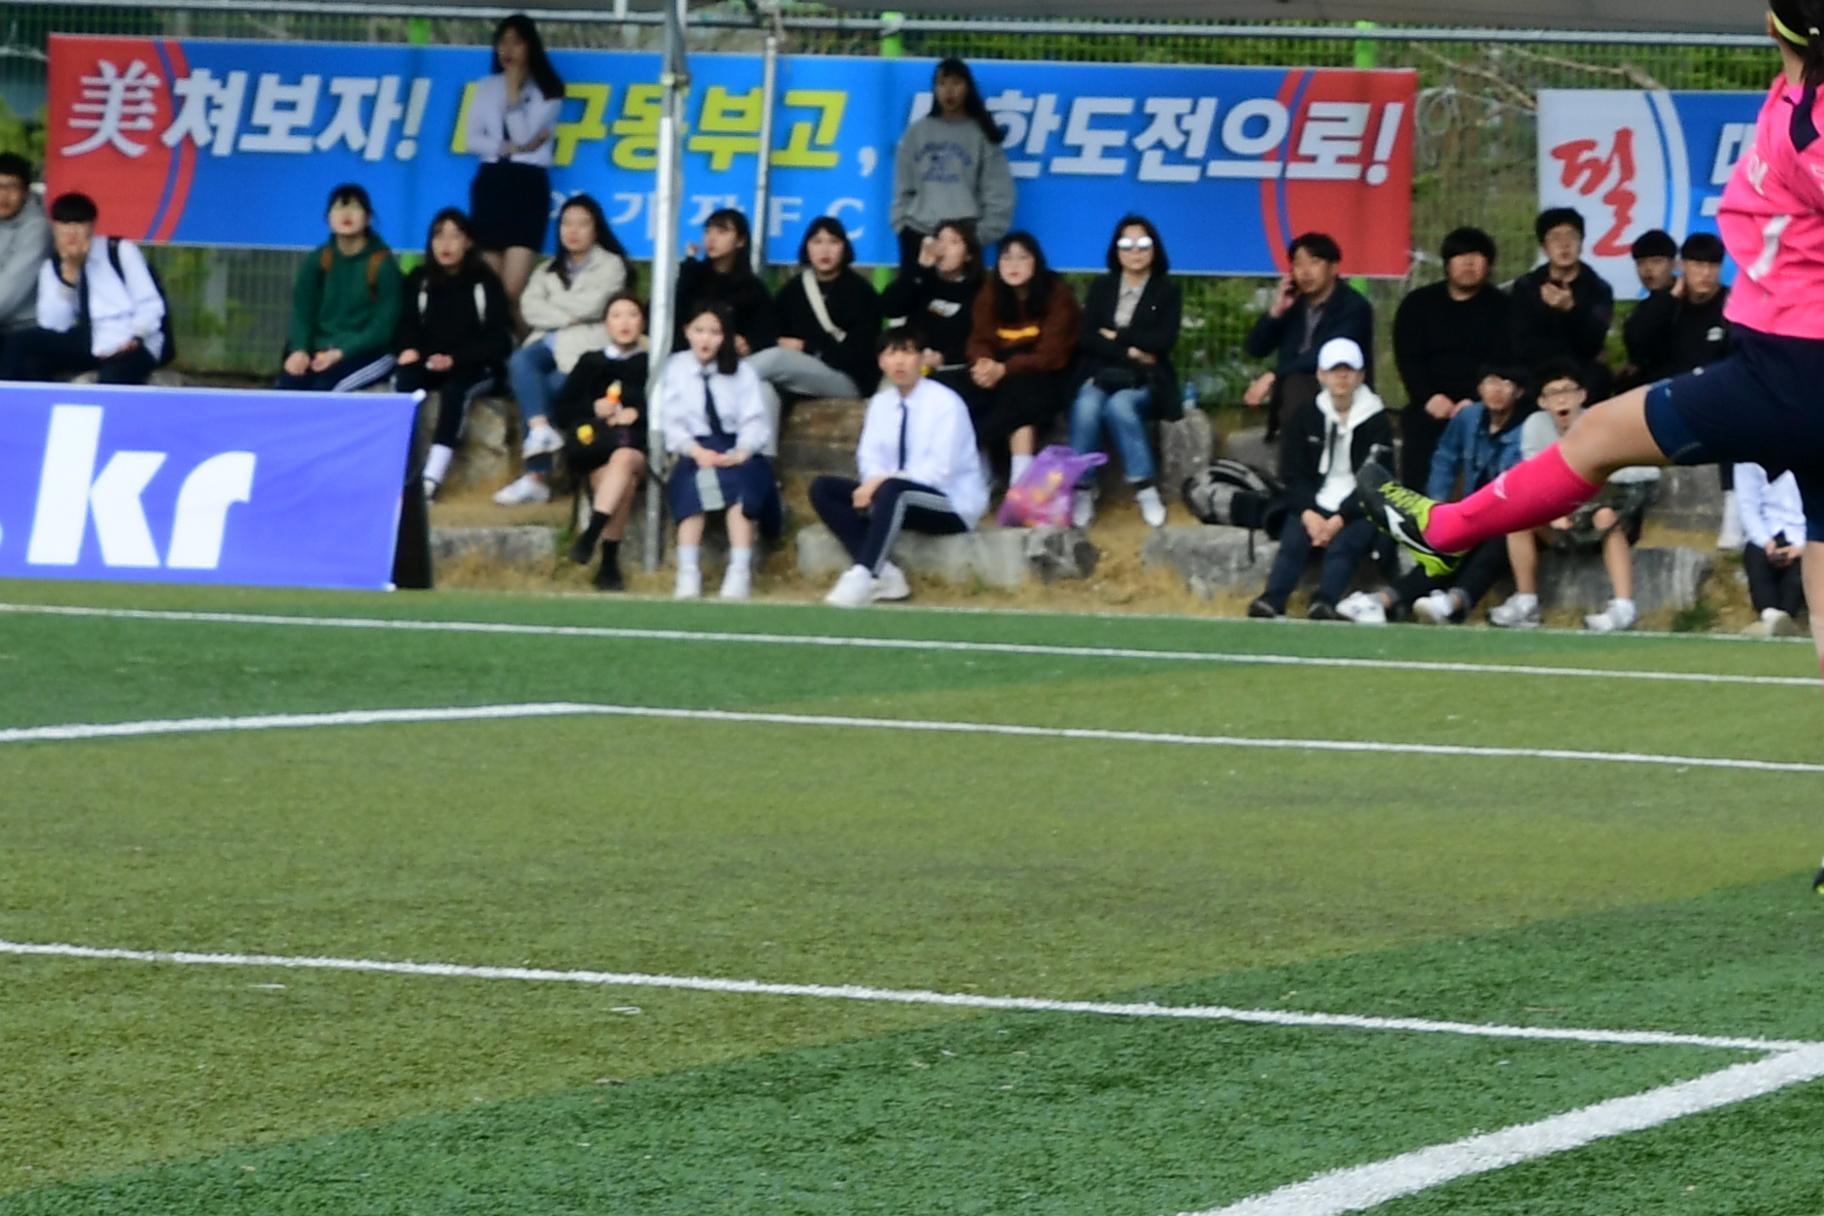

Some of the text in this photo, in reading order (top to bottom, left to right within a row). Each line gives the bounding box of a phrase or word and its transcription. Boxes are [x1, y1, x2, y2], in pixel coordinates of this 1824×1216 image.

[61, 60, 431, 161] 美쳐보자!
[452, 82, 878, 176] 구동부고,
[909, 88, 1405, 185] 한도전으로!
